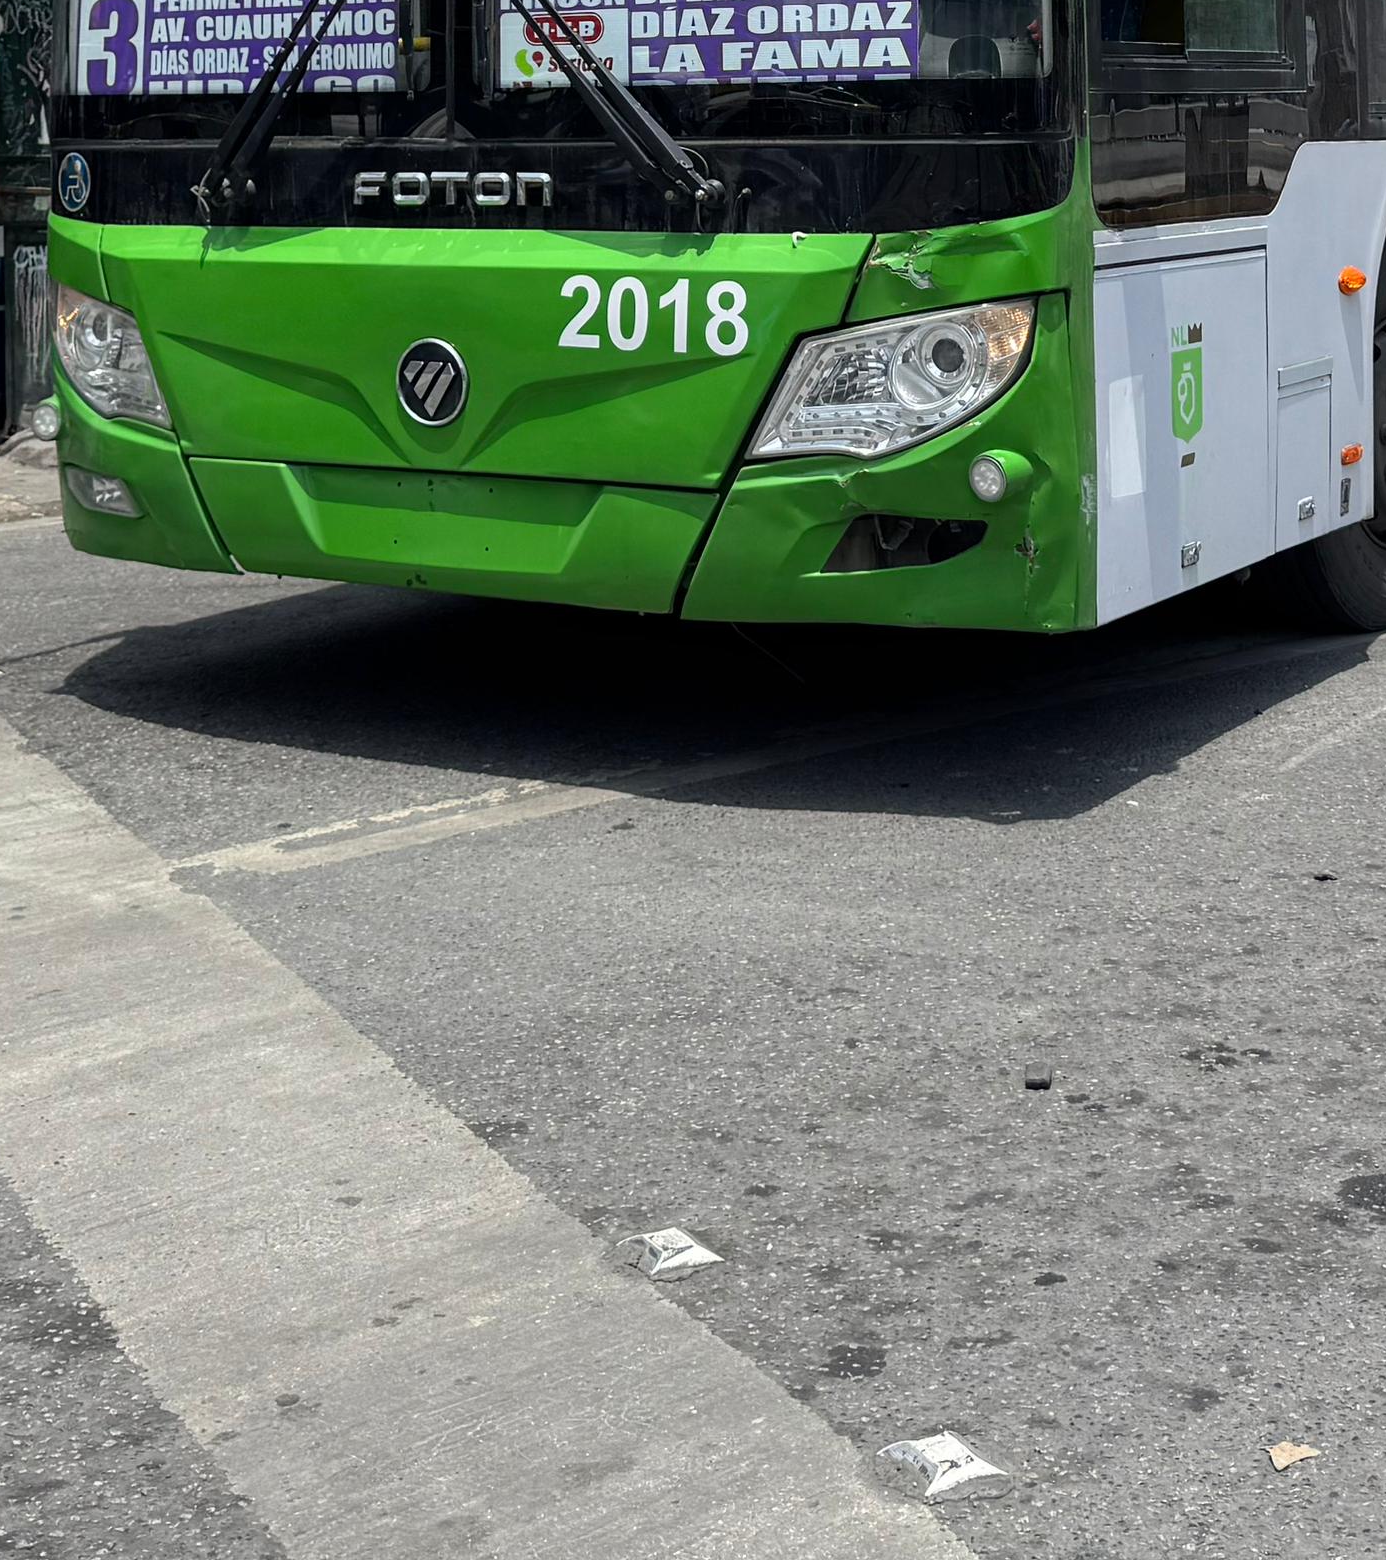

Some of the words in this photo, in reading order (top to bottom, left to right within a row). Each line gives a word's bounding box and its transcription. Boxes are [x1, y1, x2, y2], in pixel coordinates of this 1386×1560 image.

[151, 16, 190, 44] AV.
[631, 6, 735, 38] DÍAZ
[747, 1, 912, 34] ORDAZ
[150, 45, 189, 76] DÍAS
[192, 45, 250, 74] ORDAZ
[631, 43, 705, 74] LA
[722, 37, 911, 71] FAMA
[353, 171, 554, 207] FOTON
[557, 274, 750, 358] 2018
